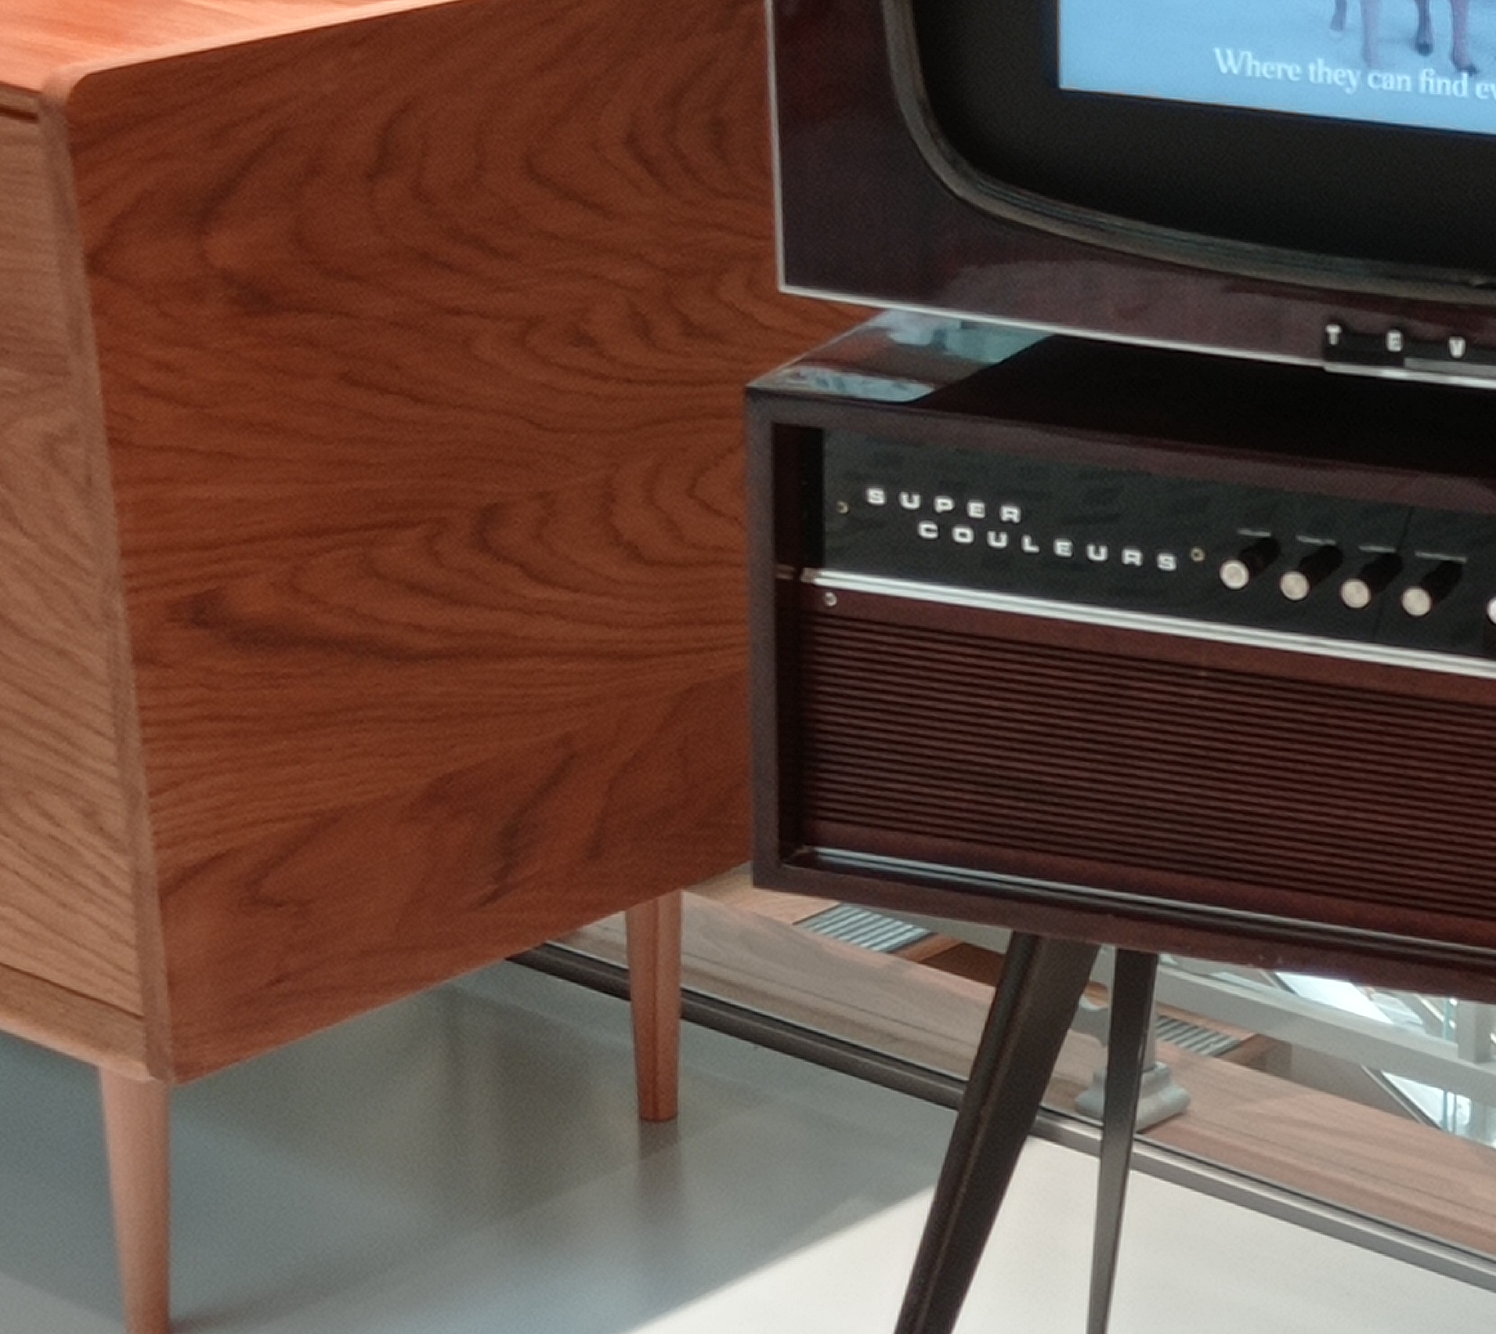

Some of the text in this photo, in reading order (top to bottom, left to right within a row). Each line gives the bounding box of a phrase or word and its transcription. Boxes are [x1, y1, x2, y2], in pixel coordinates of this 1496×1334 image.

[1213, 46, 1301, 81] Where
[1307, 58, 1361, 94] they
[1366, 69, 1412, 93] can
[1418, 68, 1469, 98] find
[866, 486, 1021, 524] SUPER
[918, 519, 1177, 571] COULEURS
